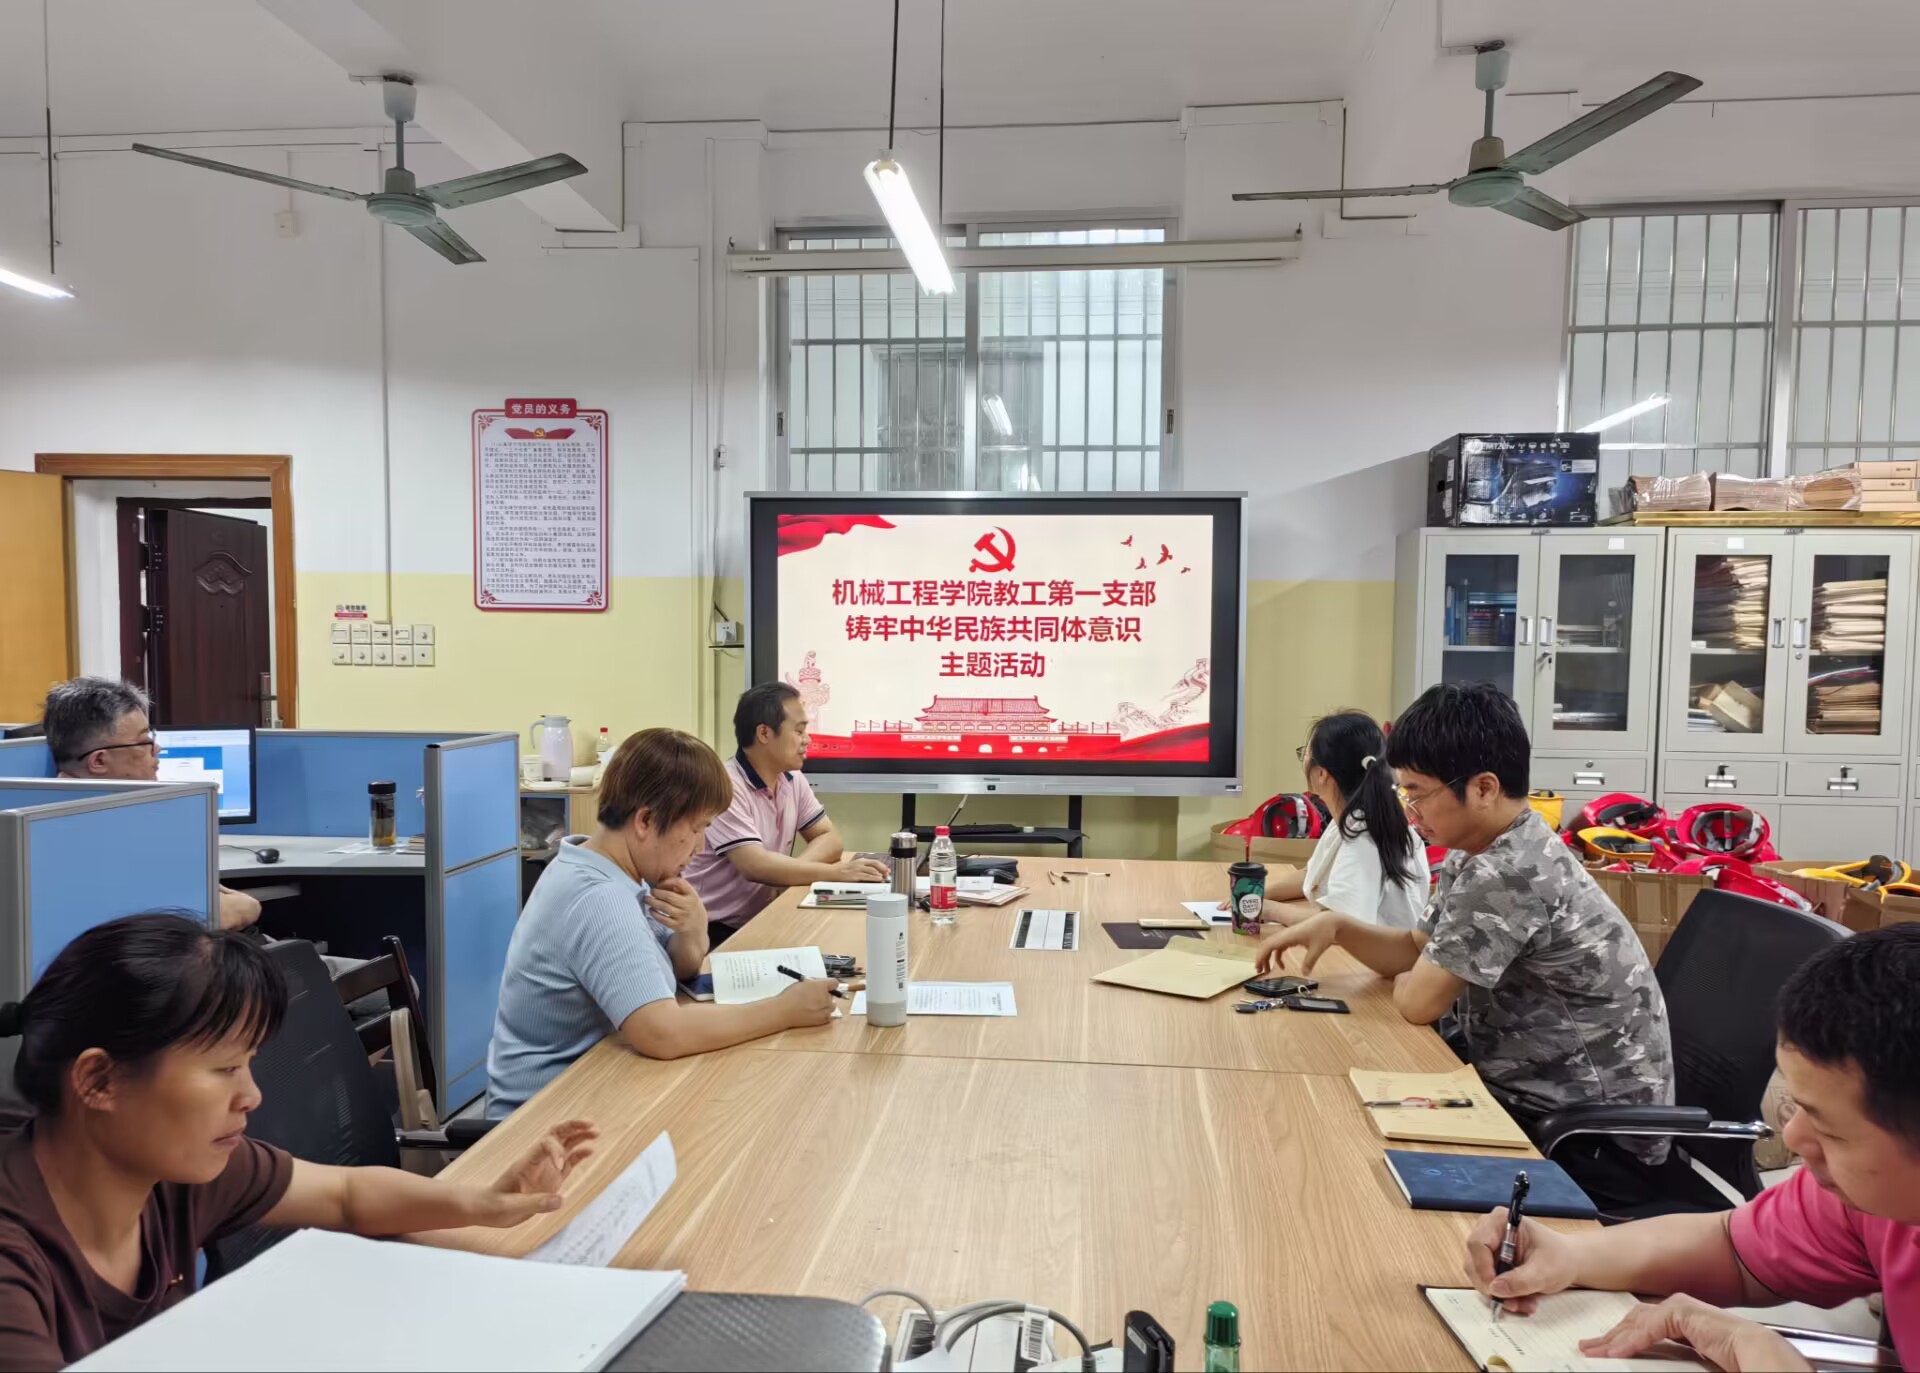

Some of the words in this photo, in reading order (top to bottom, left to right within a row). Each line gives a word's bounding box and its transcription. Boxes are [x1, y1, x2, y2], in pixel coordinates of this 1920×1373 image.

[511, 404, 571, 415] 党员的义务
[832, 579, 1156, 607] 机械工程学院教工第一支部
[845, 615, 1142, 642] 铸牢中华民族共同体意识
[939, 651, 1046, 678] 主题活动
